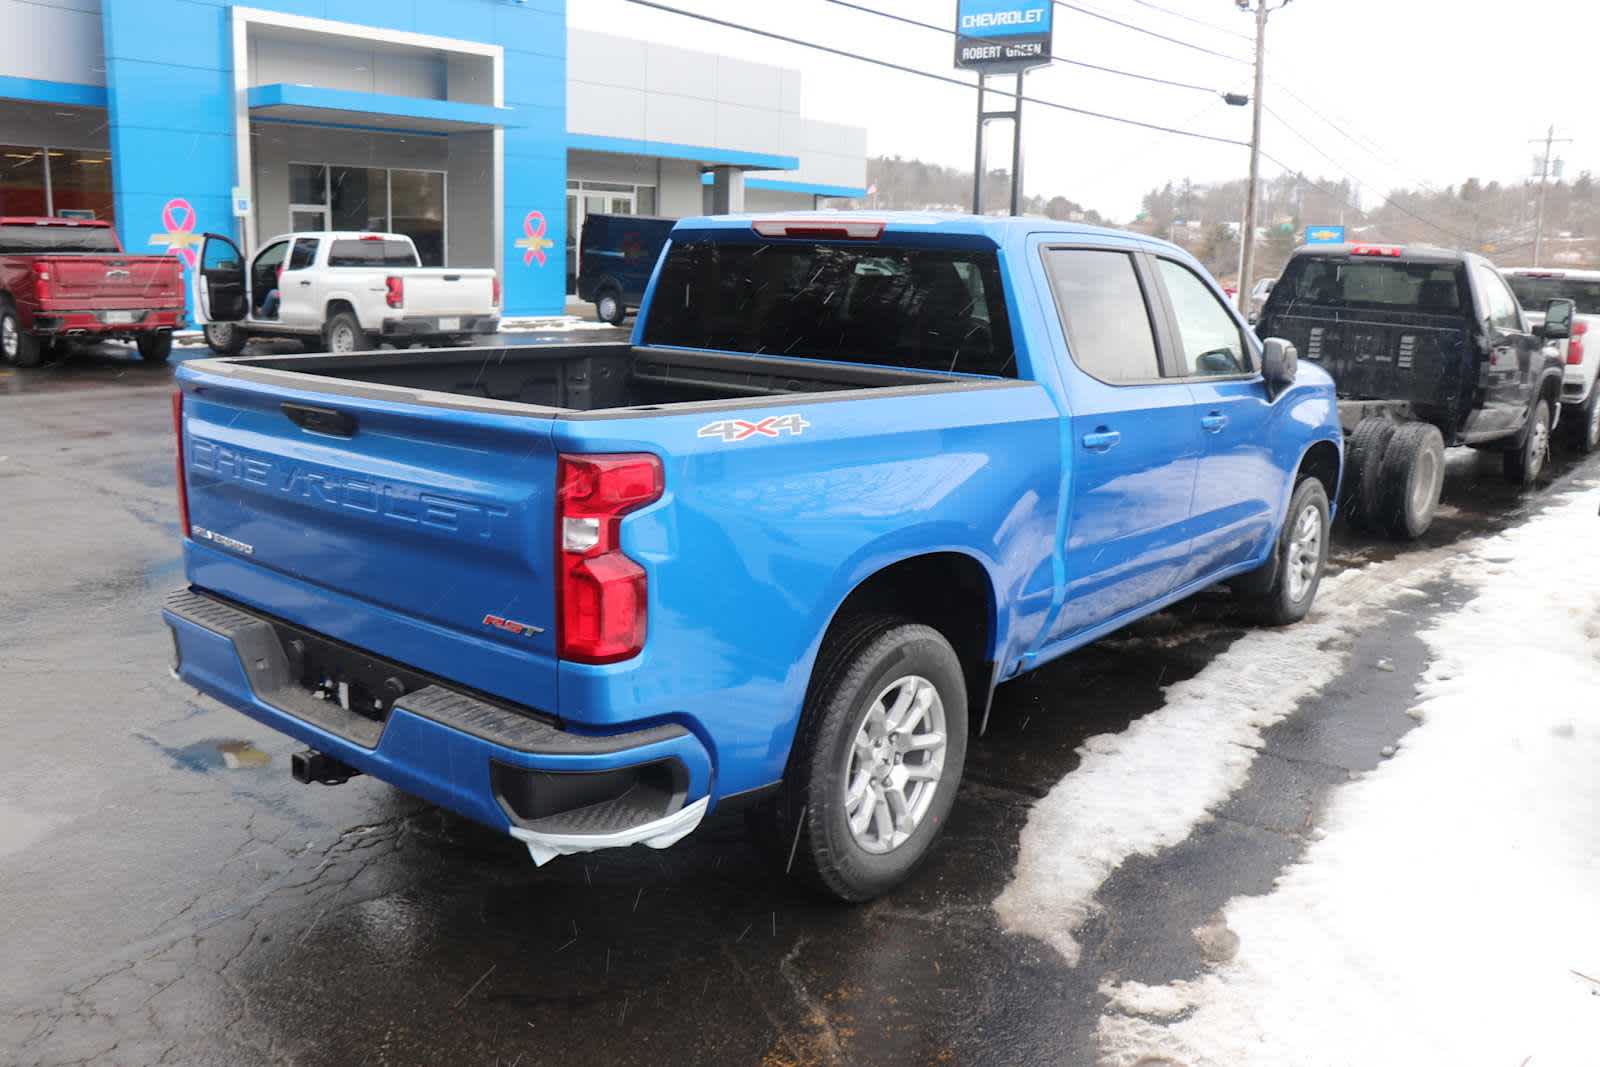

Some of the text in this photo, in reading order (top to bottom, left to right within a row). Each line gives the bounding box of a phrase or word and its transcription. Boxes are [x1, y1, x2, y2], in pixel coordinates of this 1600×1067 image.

[961, 9, 1044, 28] CHEVROLET
[962, 46, 1002, 60] ROBERT
[187, 438, 509, 539] CHEVROLET
[482, 614, 545, 638] RST
